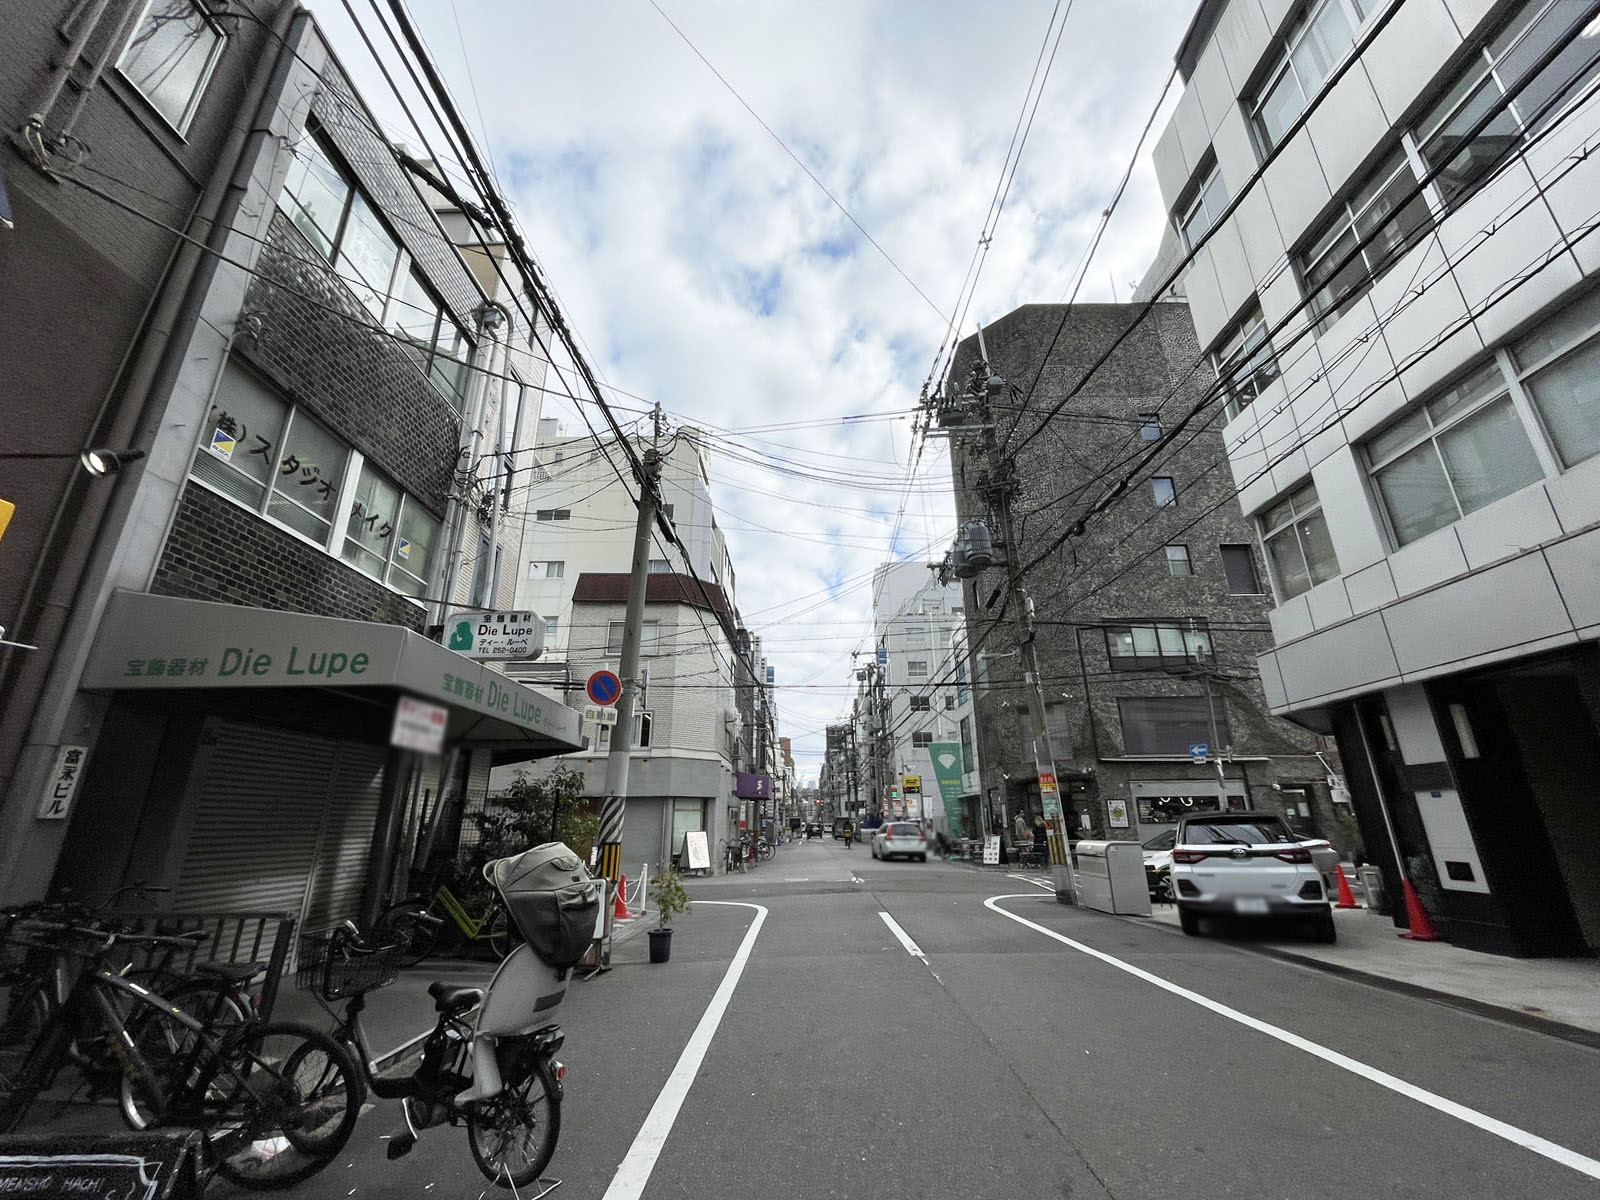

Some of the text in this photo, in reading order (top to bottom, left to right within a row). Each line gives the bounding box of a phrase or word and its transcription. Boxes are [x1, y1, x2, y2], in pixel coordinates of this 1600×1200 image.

[478, 624, 533, 638] Die Lupe
[492, 646, 527, 654] 252-0400
[123, 646, 369, 678] 宝飾器材 Die Lupe
[487, 680, 509, 713] Die
[512, 691, 542, 723] Lupe
